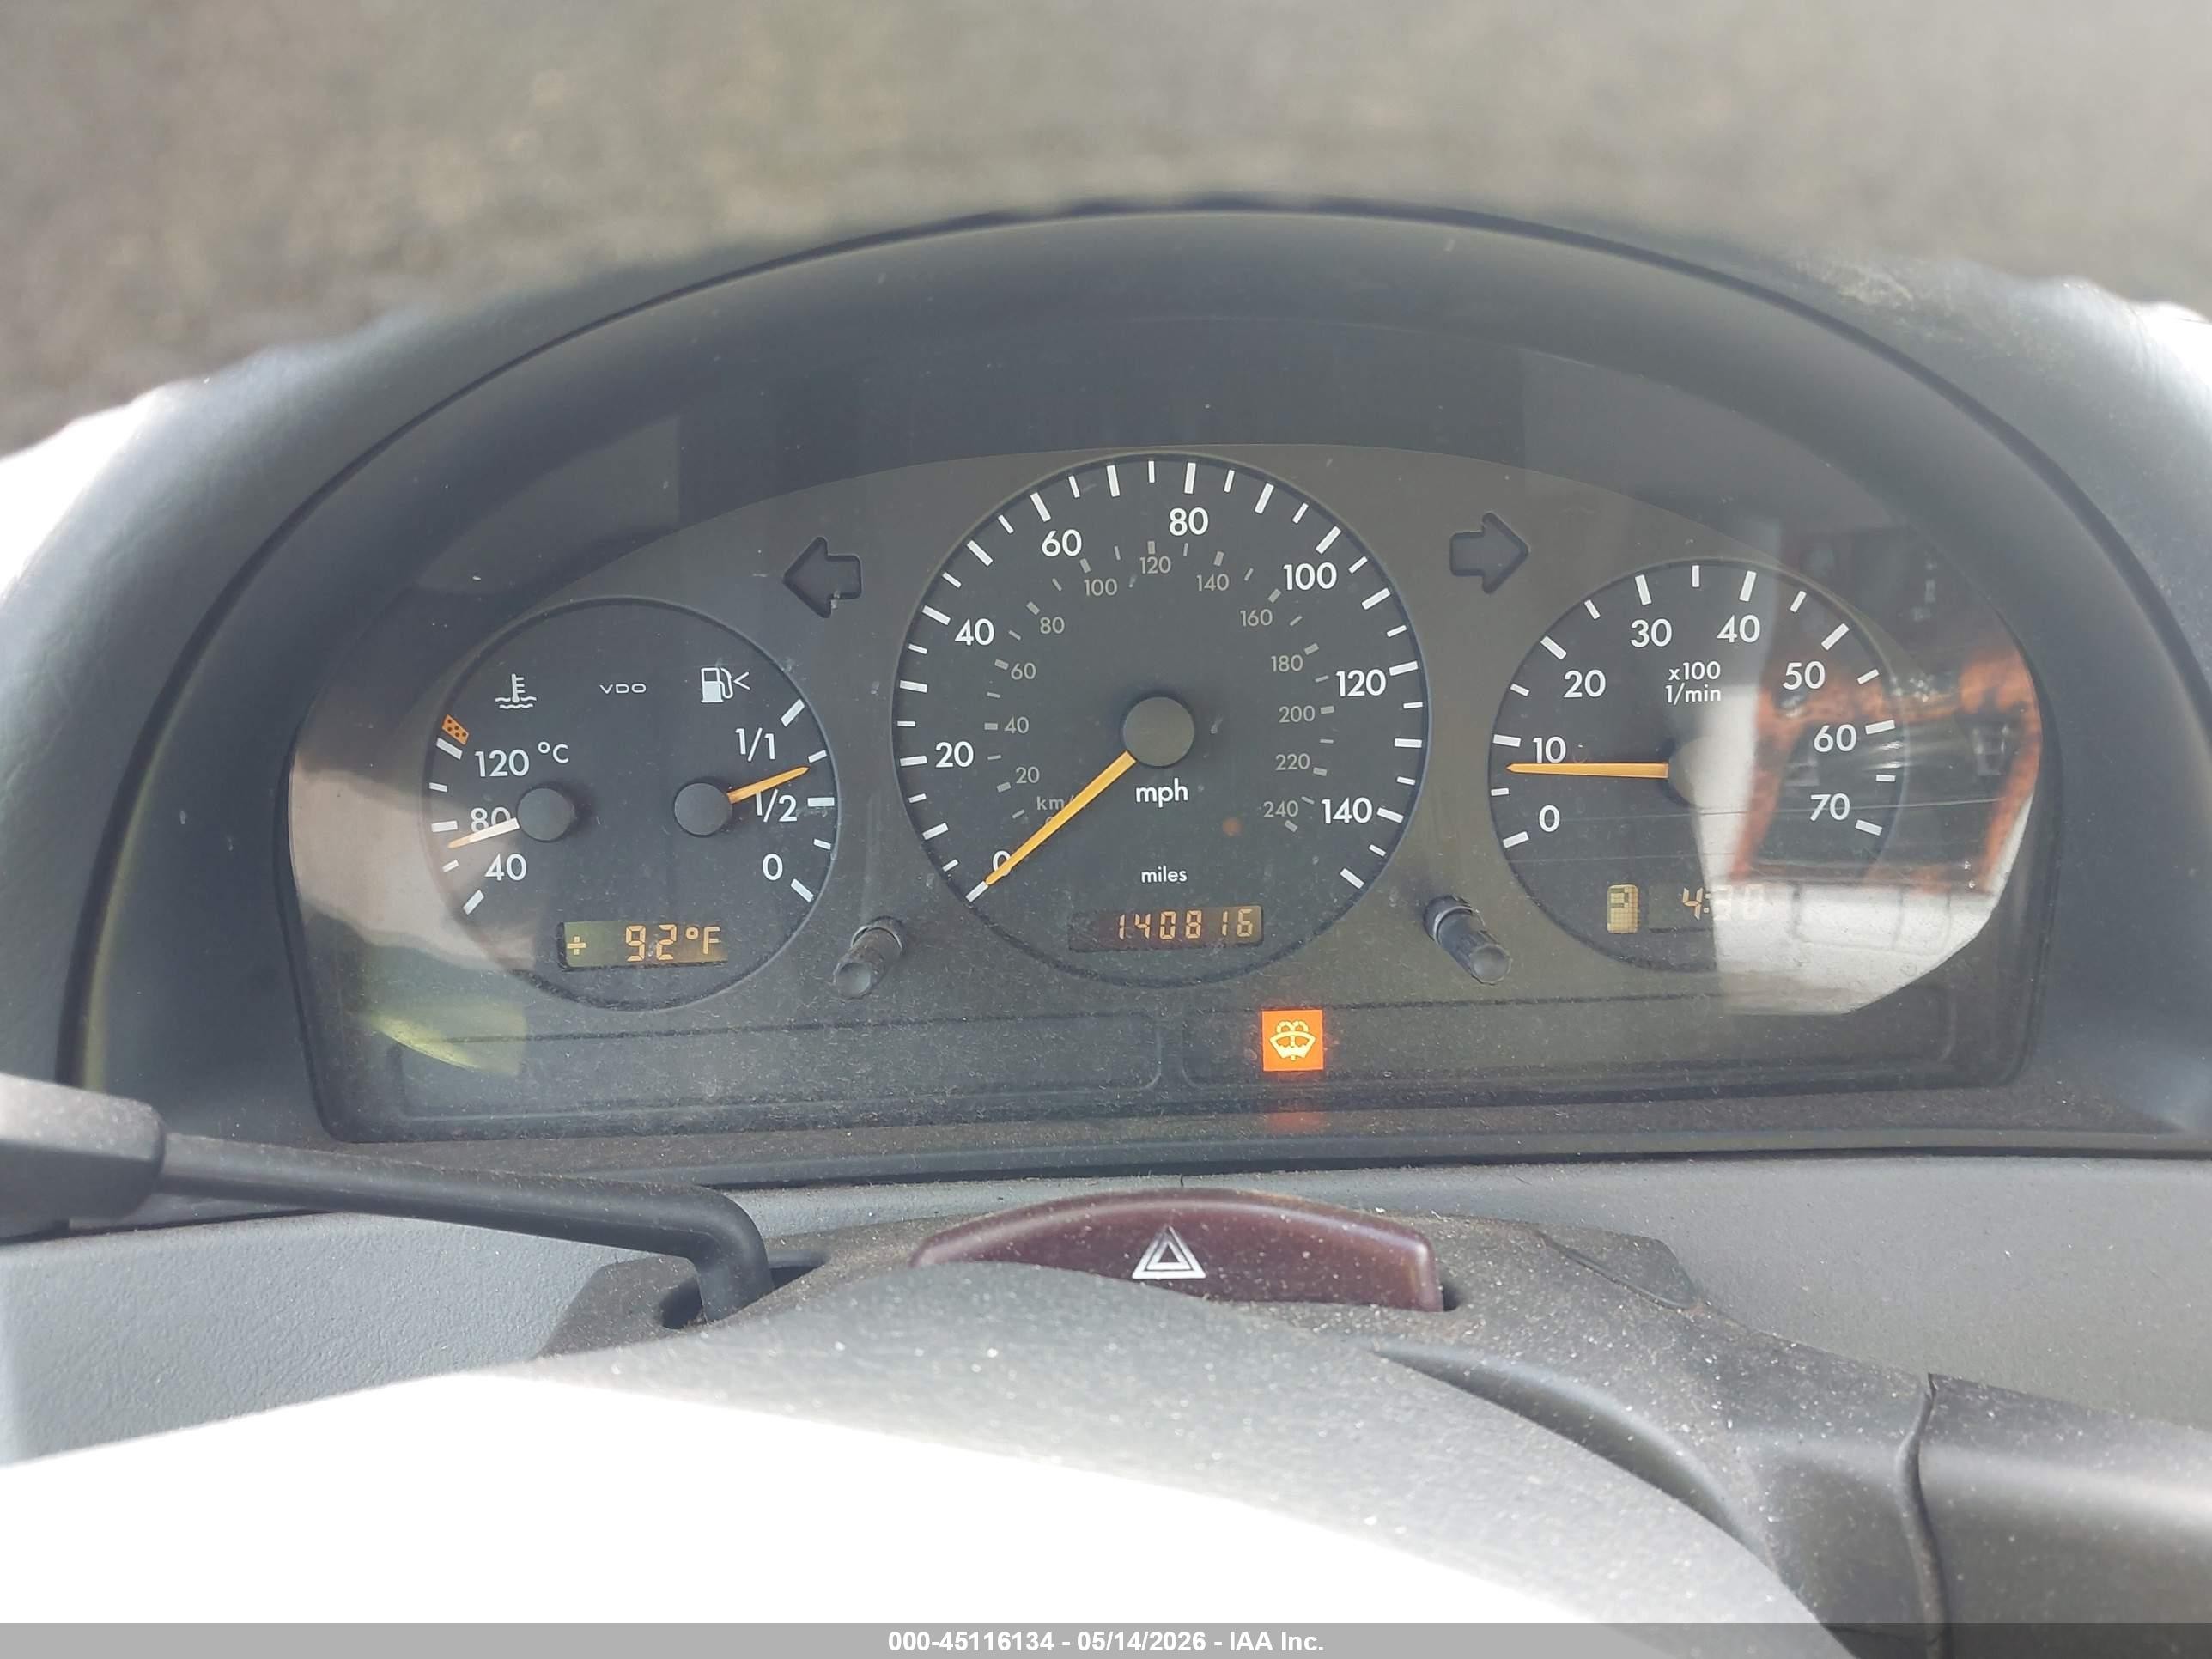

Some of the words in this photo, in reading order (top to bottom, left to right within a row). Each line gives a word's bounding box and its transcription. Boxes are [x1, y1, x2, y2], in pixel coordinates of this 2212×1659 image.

[1169, 507, 1209, 536] 80
[1041, 529, 1082, 557] 60
[1139, 556, 1171, 574] 120
[1283, 562, 1337, 591] 100
[1084, 578, 1117, 596] 100
[1196, 574, 1230, 592] 140
[954, 617, 994, 646] 40
[1039, 617, 1065, 634] 80
[1240, 609, 1273, 627] 160
[1717, 614, 1760, 643] 40
[1631, 618, 1672, 647] 30
[1010, 662, 1036, 680] 60
[1271, 654, 1304, 672] 180
[1668, 662, 1721, 681] x100
[1783, 662, 1826, 690] 50
[599, 683, 647, 695] VDO
[1335, 668, 1387, 697] 120
[1563, 669, 1607, 698] 20
[1665, 684, 1721, 705] 1/min
[1004, 716, 1030, 733] 40
[1279, 705, 1316, 723] 200
[735, 727, 776, 762] 1/1
[1533, 737, 1566, 763] 10
[1814, 724, 1857, 752] 60
[475, 749, 530, 777] 120
[935, 741, 974, 768] 20
[1275, 753, 1310, 771] 220
[1016, 766, 1040, 784] 20
[755, 788, 798, 823] 1/2
[1135, 778, 1188, 808] mph
[470, 806, 513, 832] 80
[1263, 800, 1299, 818] 240
[1321, 797, 1372, 824] 140
[1538, 805, 1560, 832] 0
[1809, 793, 1850, 821] 70
[484, 854, 527, 881] 40
[762, 854, 783, 880] 0
[1140, 866, 1188, 884] miles
[1119, 908, 1253, 939] 140816
